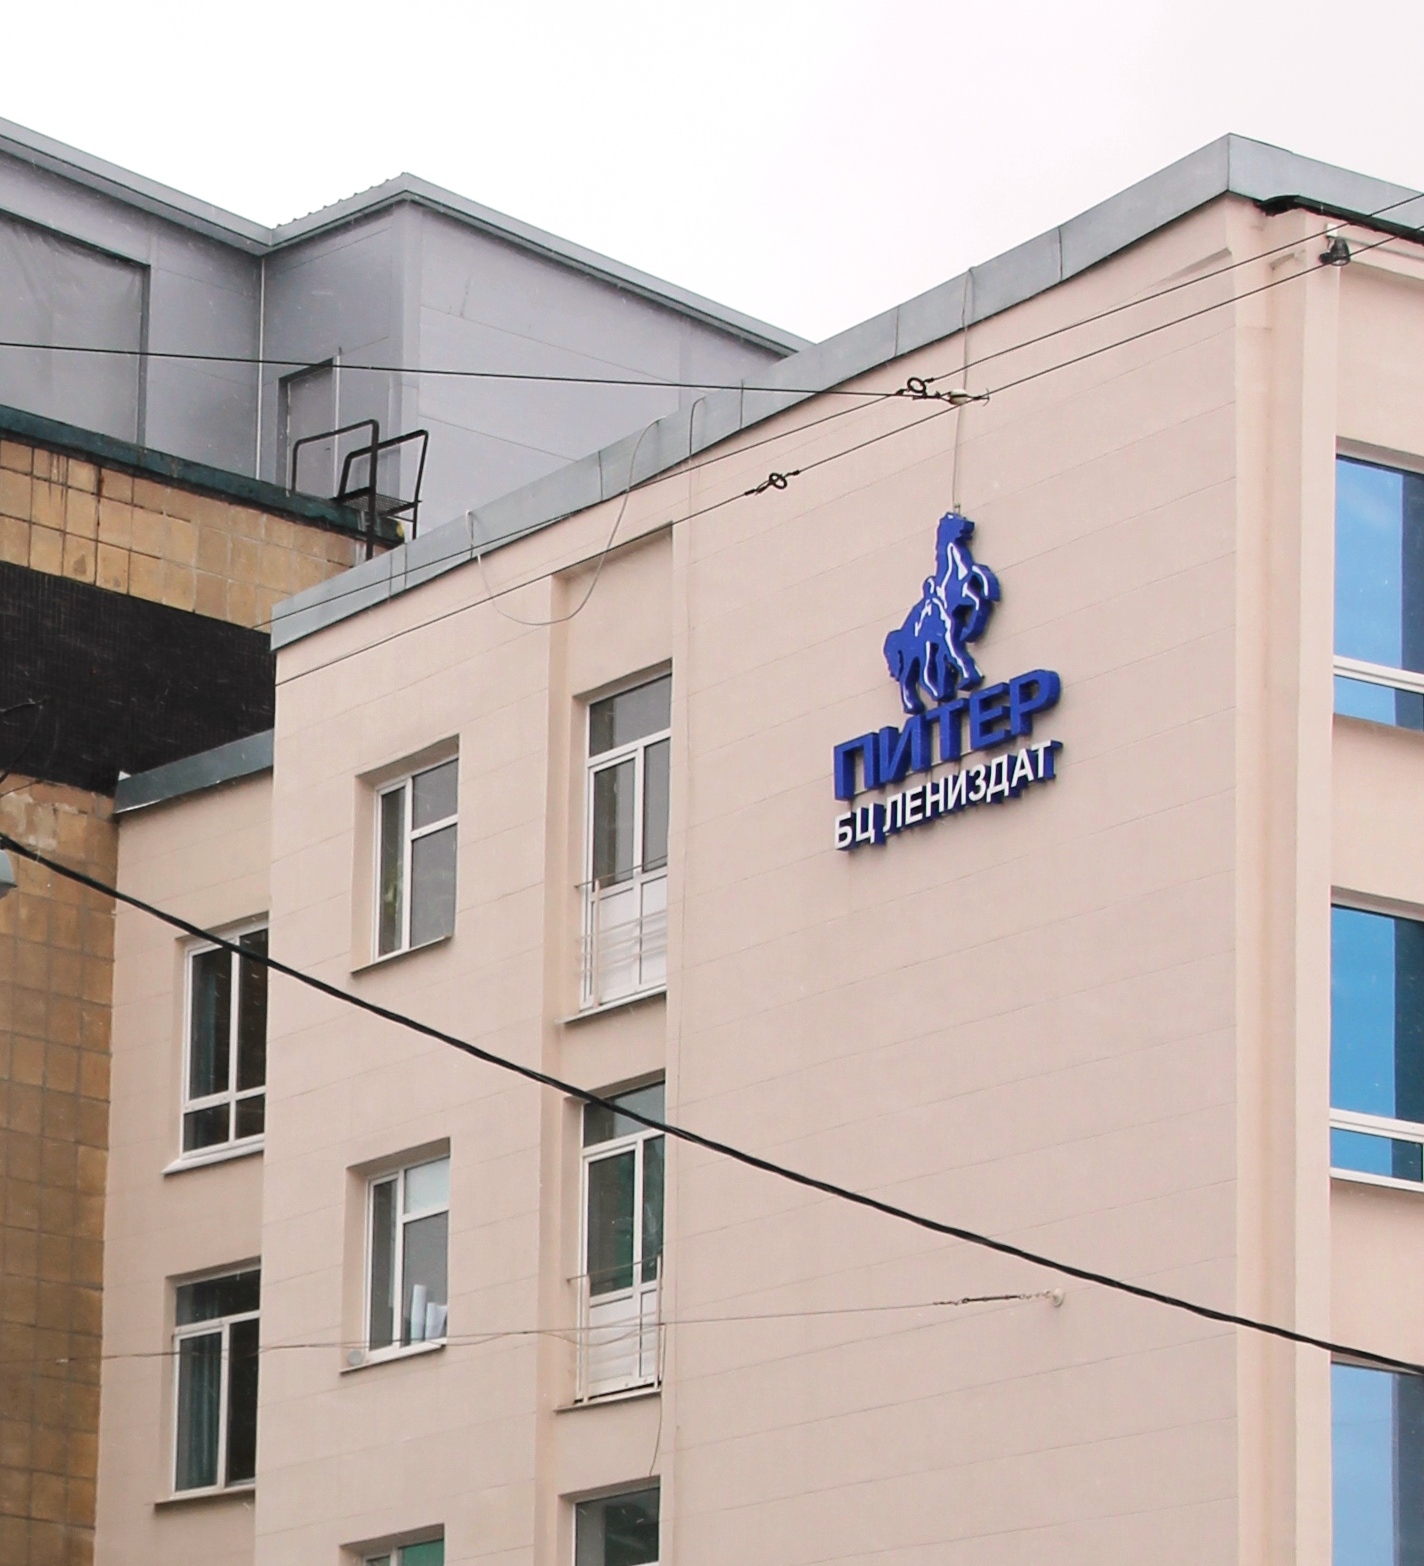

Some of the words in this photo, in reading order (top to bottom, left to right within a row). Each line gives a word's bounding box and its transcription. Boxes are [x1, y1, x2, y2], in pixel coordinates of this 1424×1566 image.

[834, 668, 1062, 801] ПИТЕР
[834, 803, 885, 852] БЦ
[882, 740, 1063, 836] ЛЕНИЗДАТ
